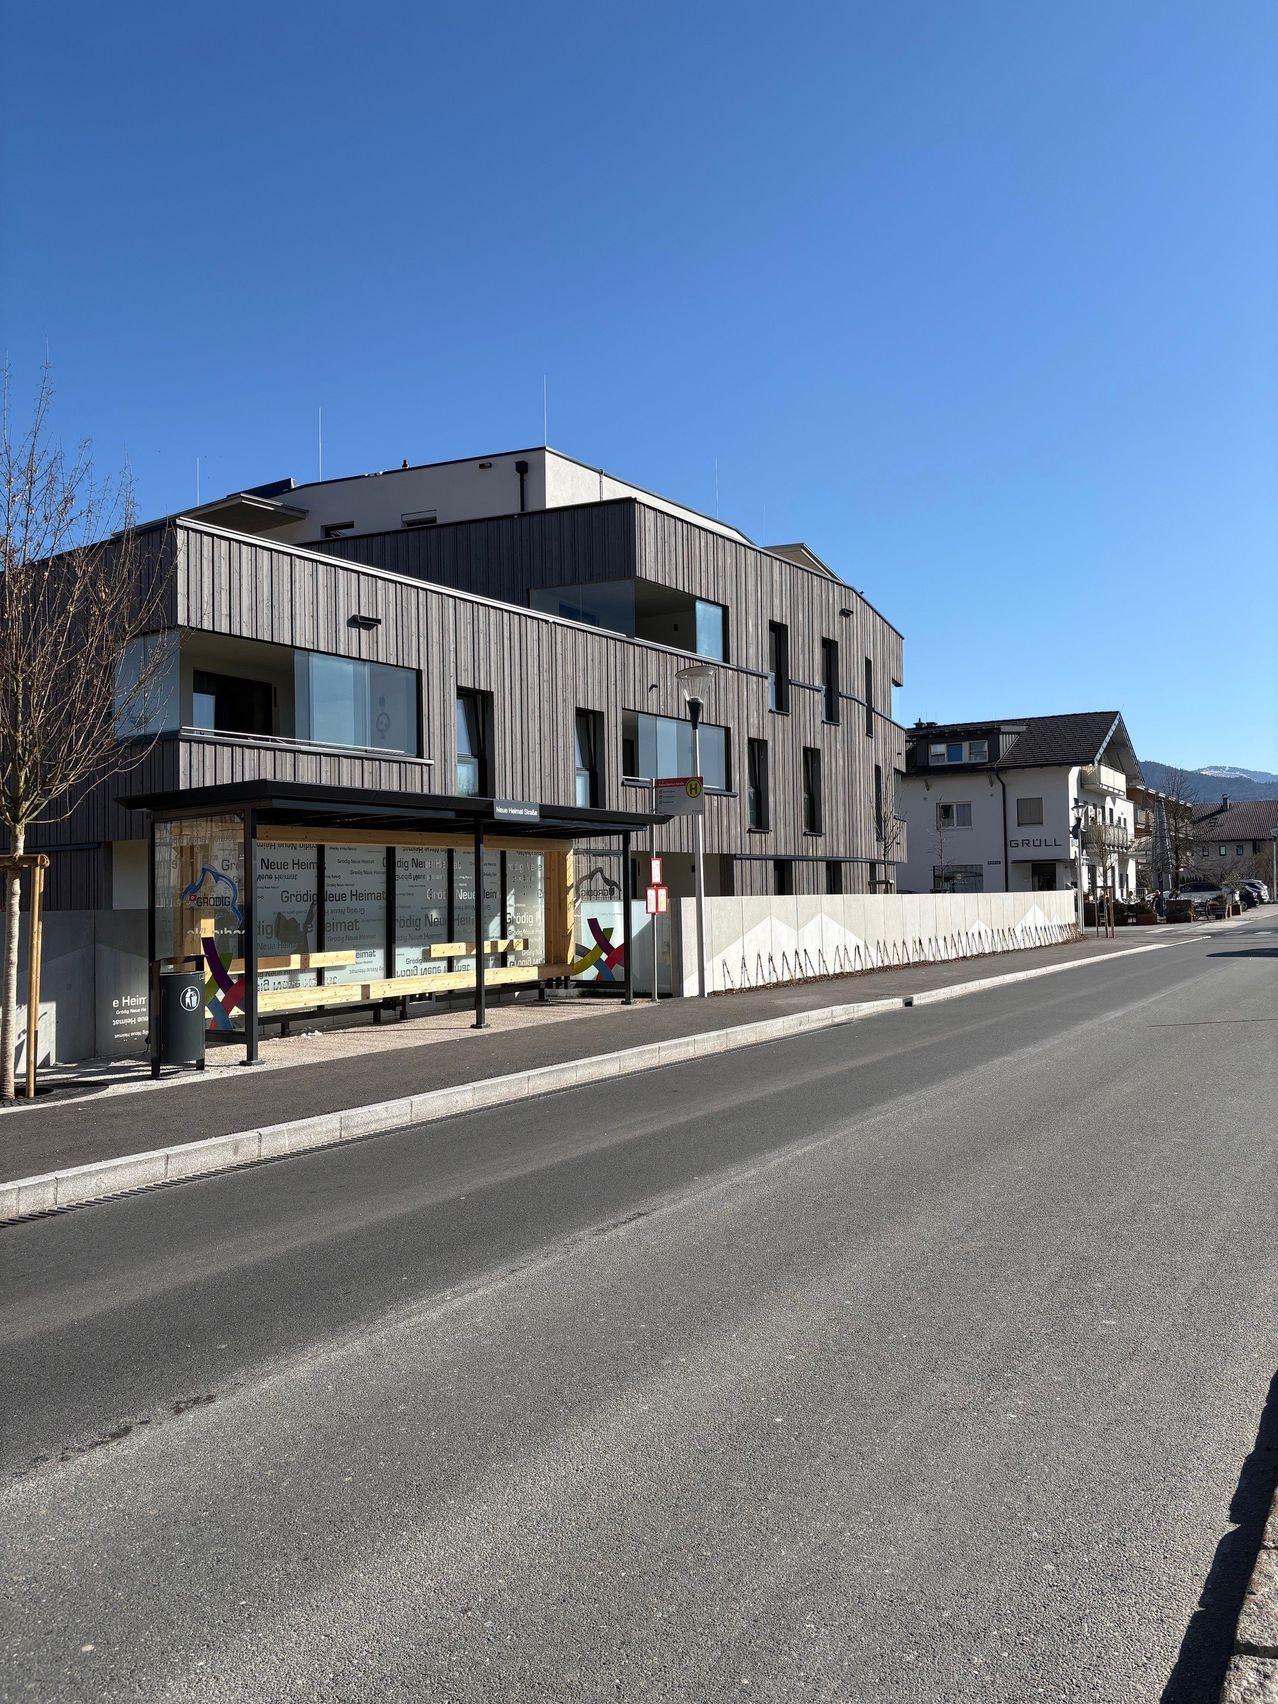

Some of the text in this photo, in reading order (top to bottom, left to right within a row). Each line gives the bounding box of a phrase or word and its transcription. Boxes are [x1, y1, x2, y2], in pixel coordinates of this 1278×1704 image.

[689, 782, 698, 795] H
[496, 806, 508, 814] Neue
[509, 807, 524, 815] Heimat
[1009, 838, 1063, 848] GRÜLL
[260, 858, 326, 871] Neue Heim
[325, 890, 347, 902] eue
[350, 889, 387, 902] Heimat
[325, 919, 360, 933] eimat
[355, 949, 377, 959] eimat
